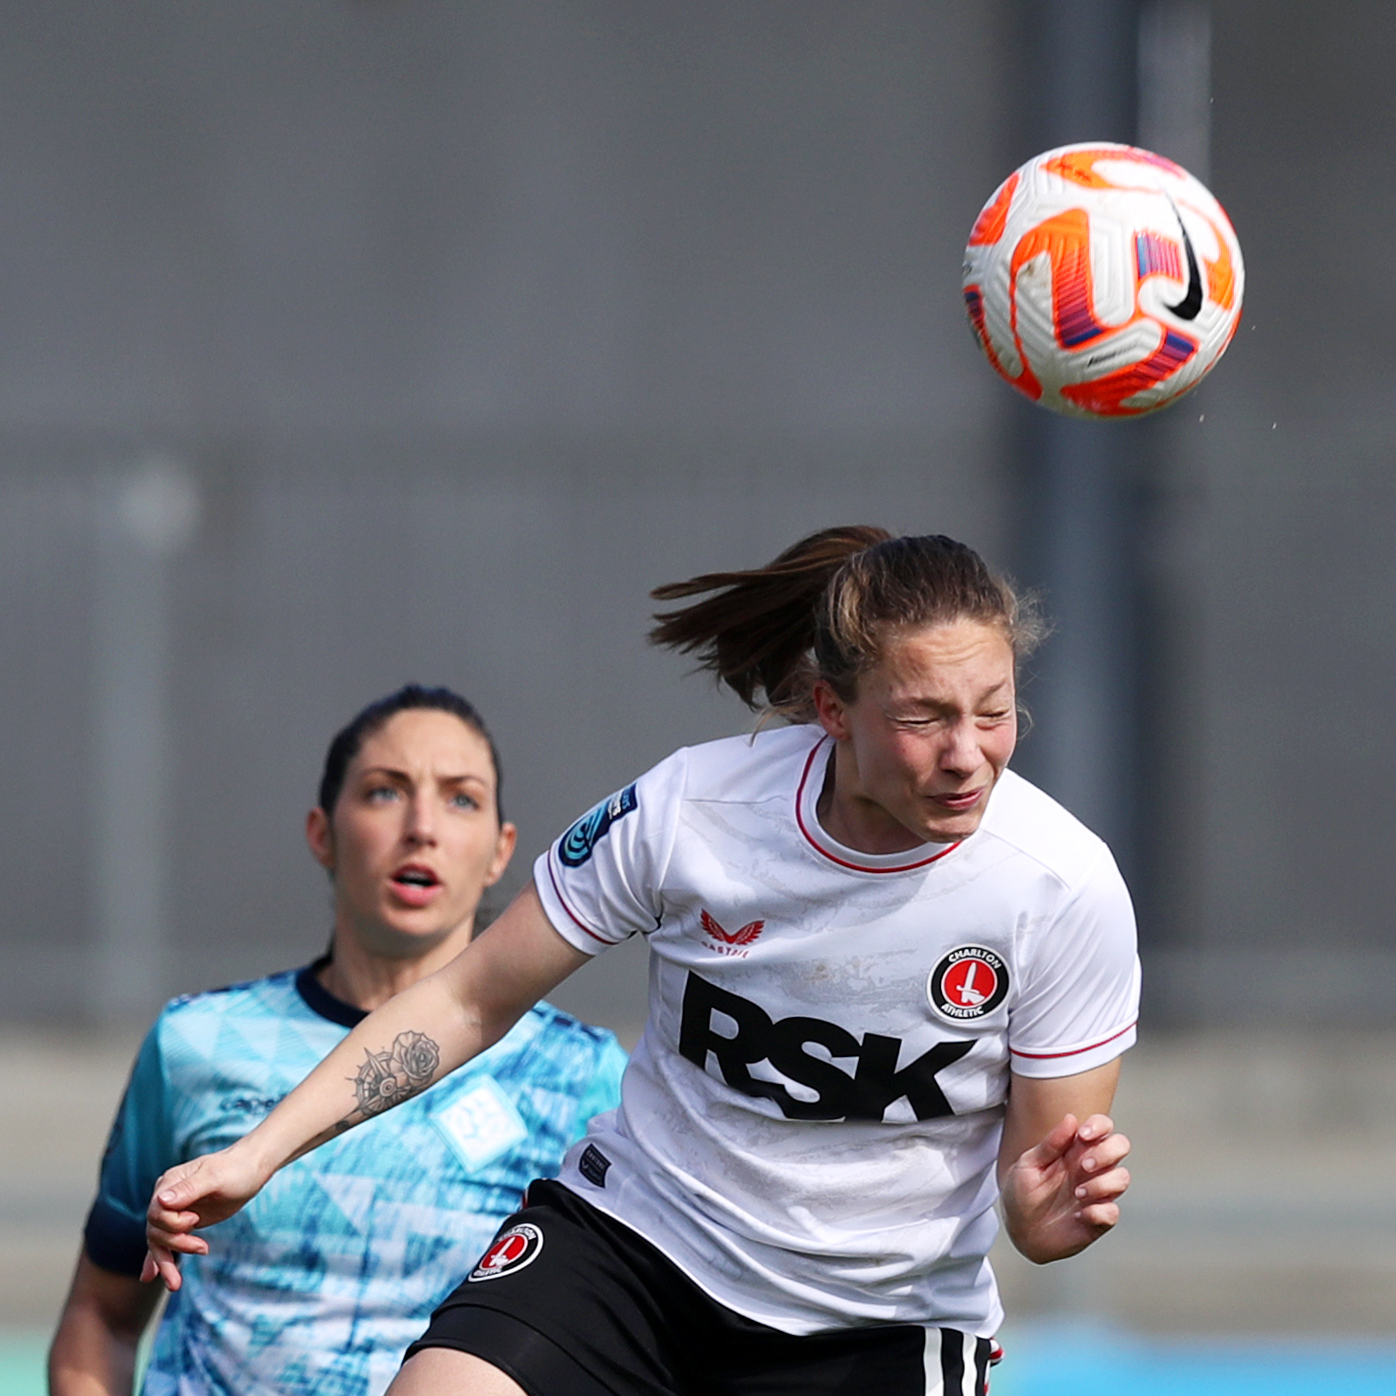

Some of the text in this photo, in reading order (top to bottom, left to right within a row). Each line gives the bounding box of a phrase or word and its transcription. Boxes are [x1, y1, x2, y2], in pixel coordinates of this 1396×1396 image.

[948, 948, 1002, 970] CHARLTON
[941, 1003, 985, 1018] ATHLETIC
[680, 970, 978, 1123] RSK
